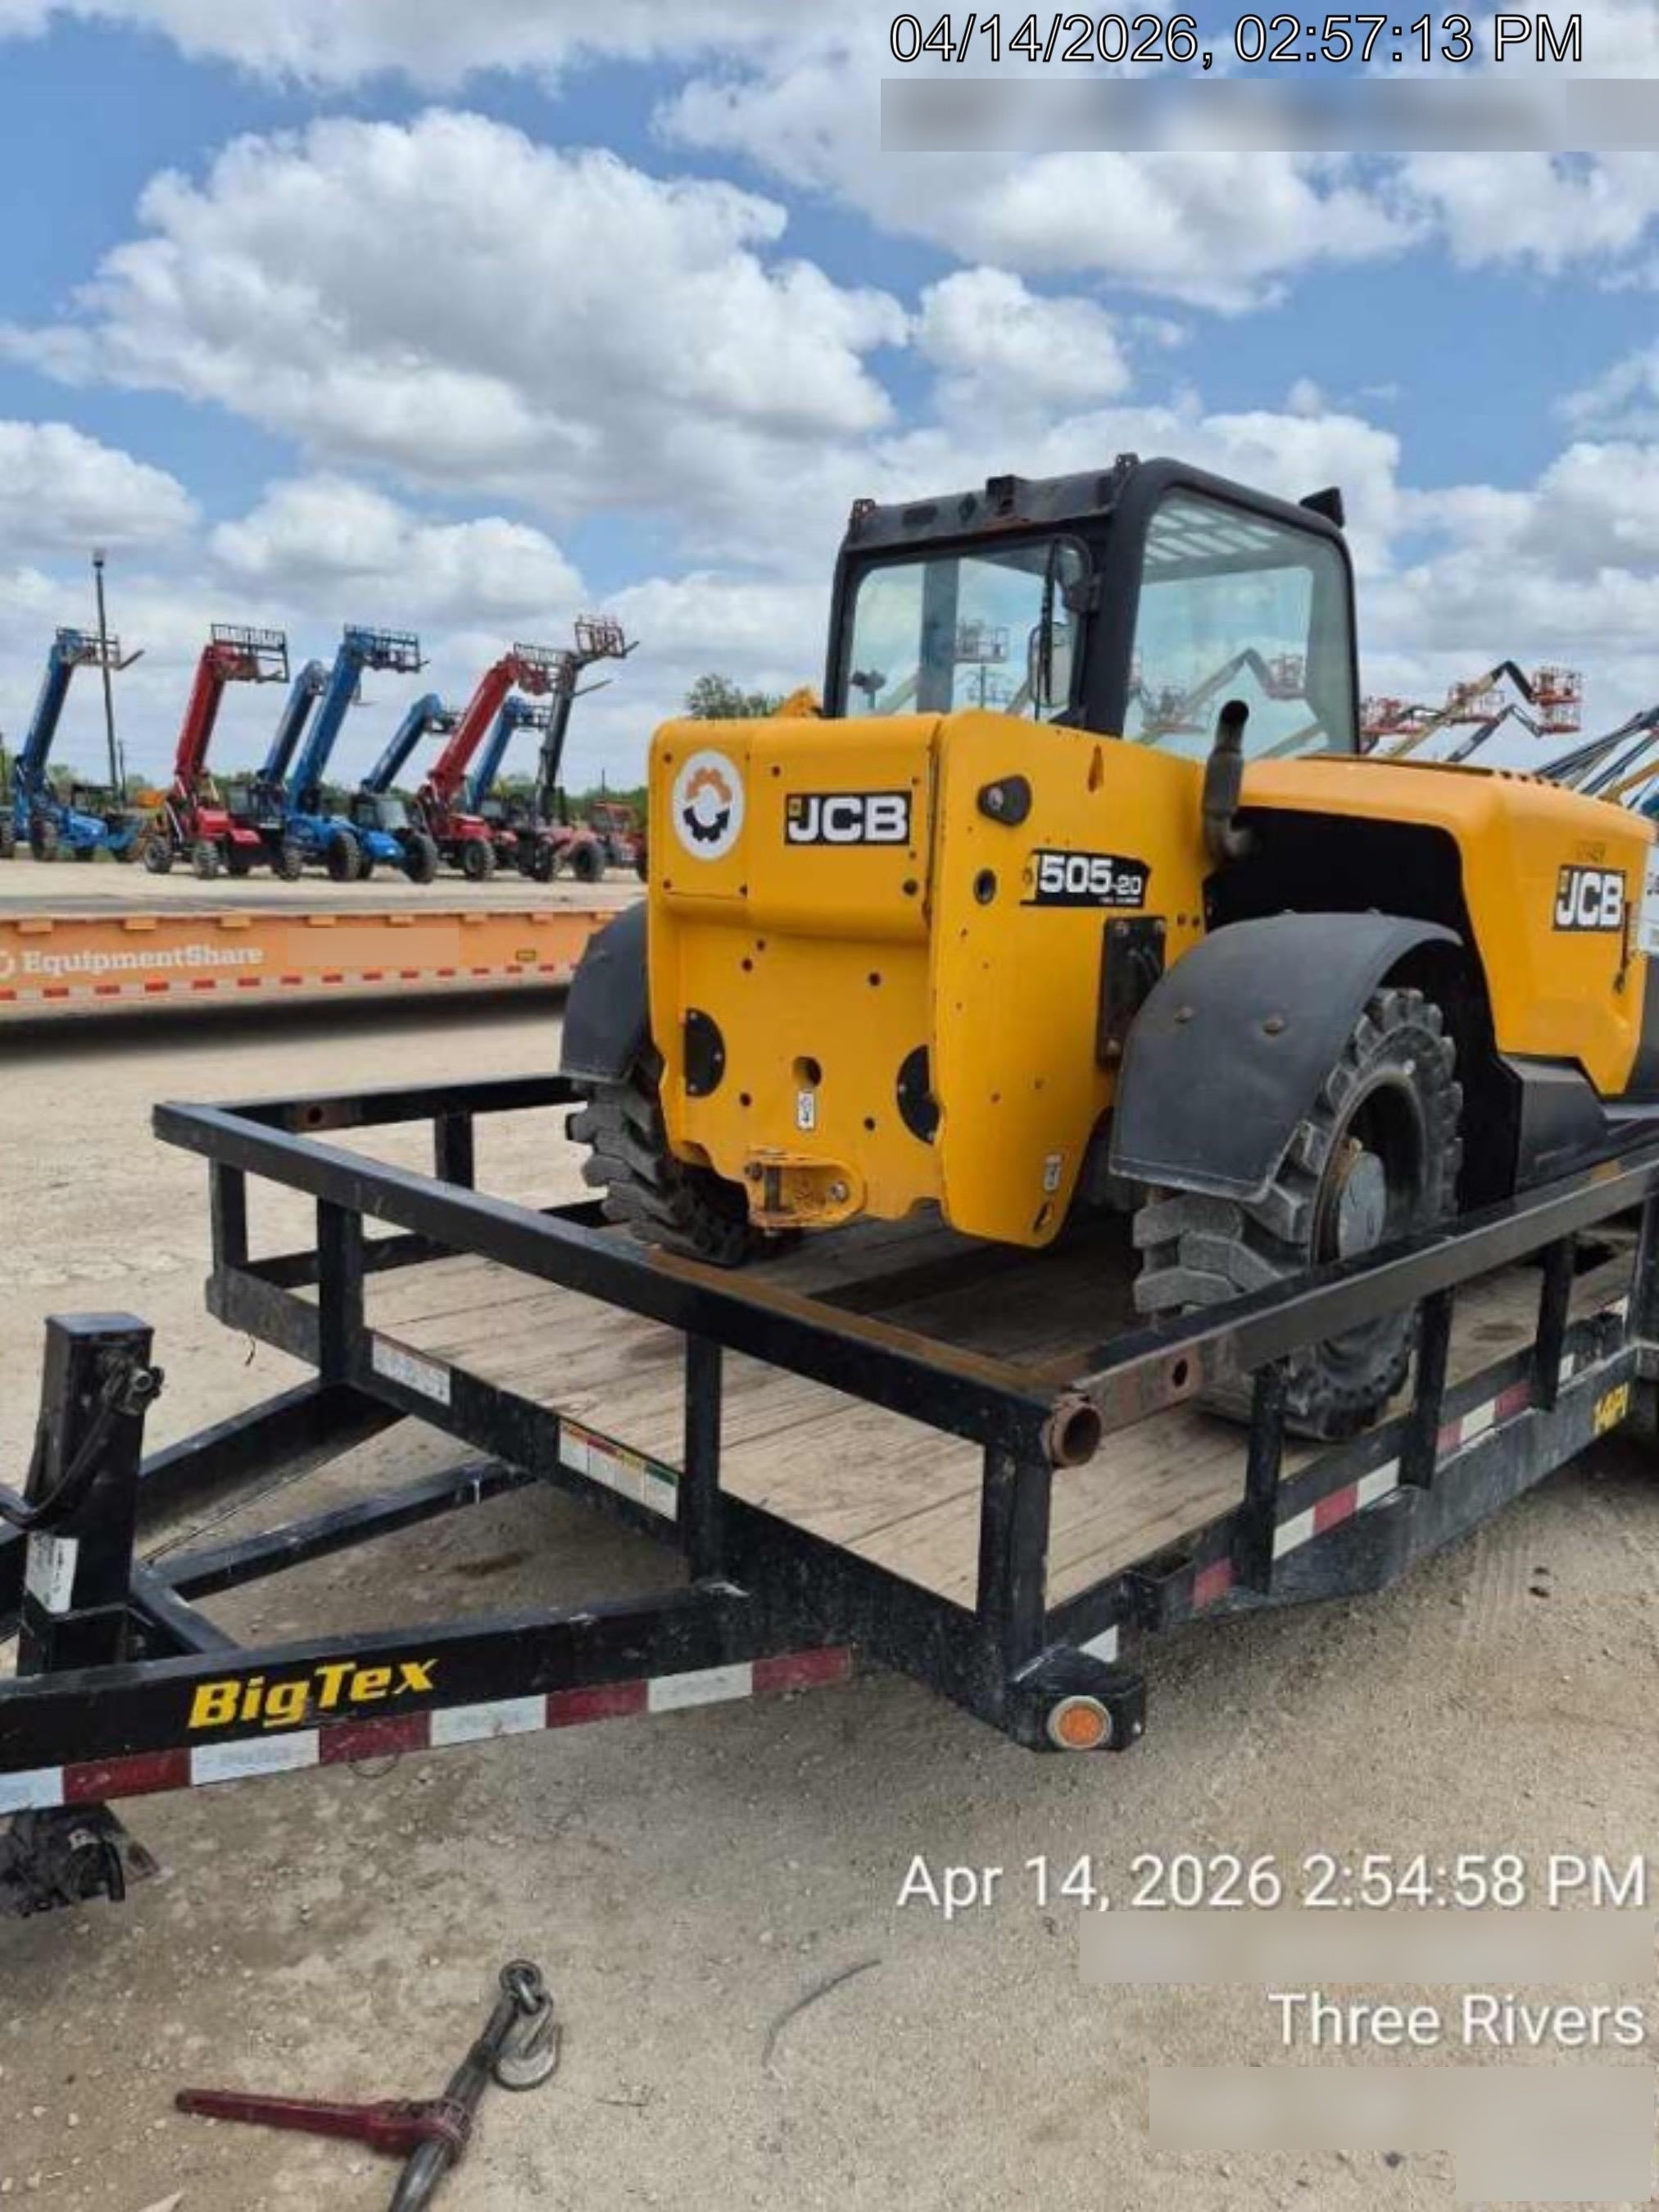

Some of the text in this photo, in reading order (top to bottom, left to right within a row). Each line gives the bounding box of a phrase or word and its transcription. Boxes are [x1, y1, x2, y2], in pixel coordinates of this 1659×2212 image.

[788, 796, 907, 841] JCB
[1557, 871, 1623, 927] JCB
[20, 944, 263, 976] EquipmentShare
